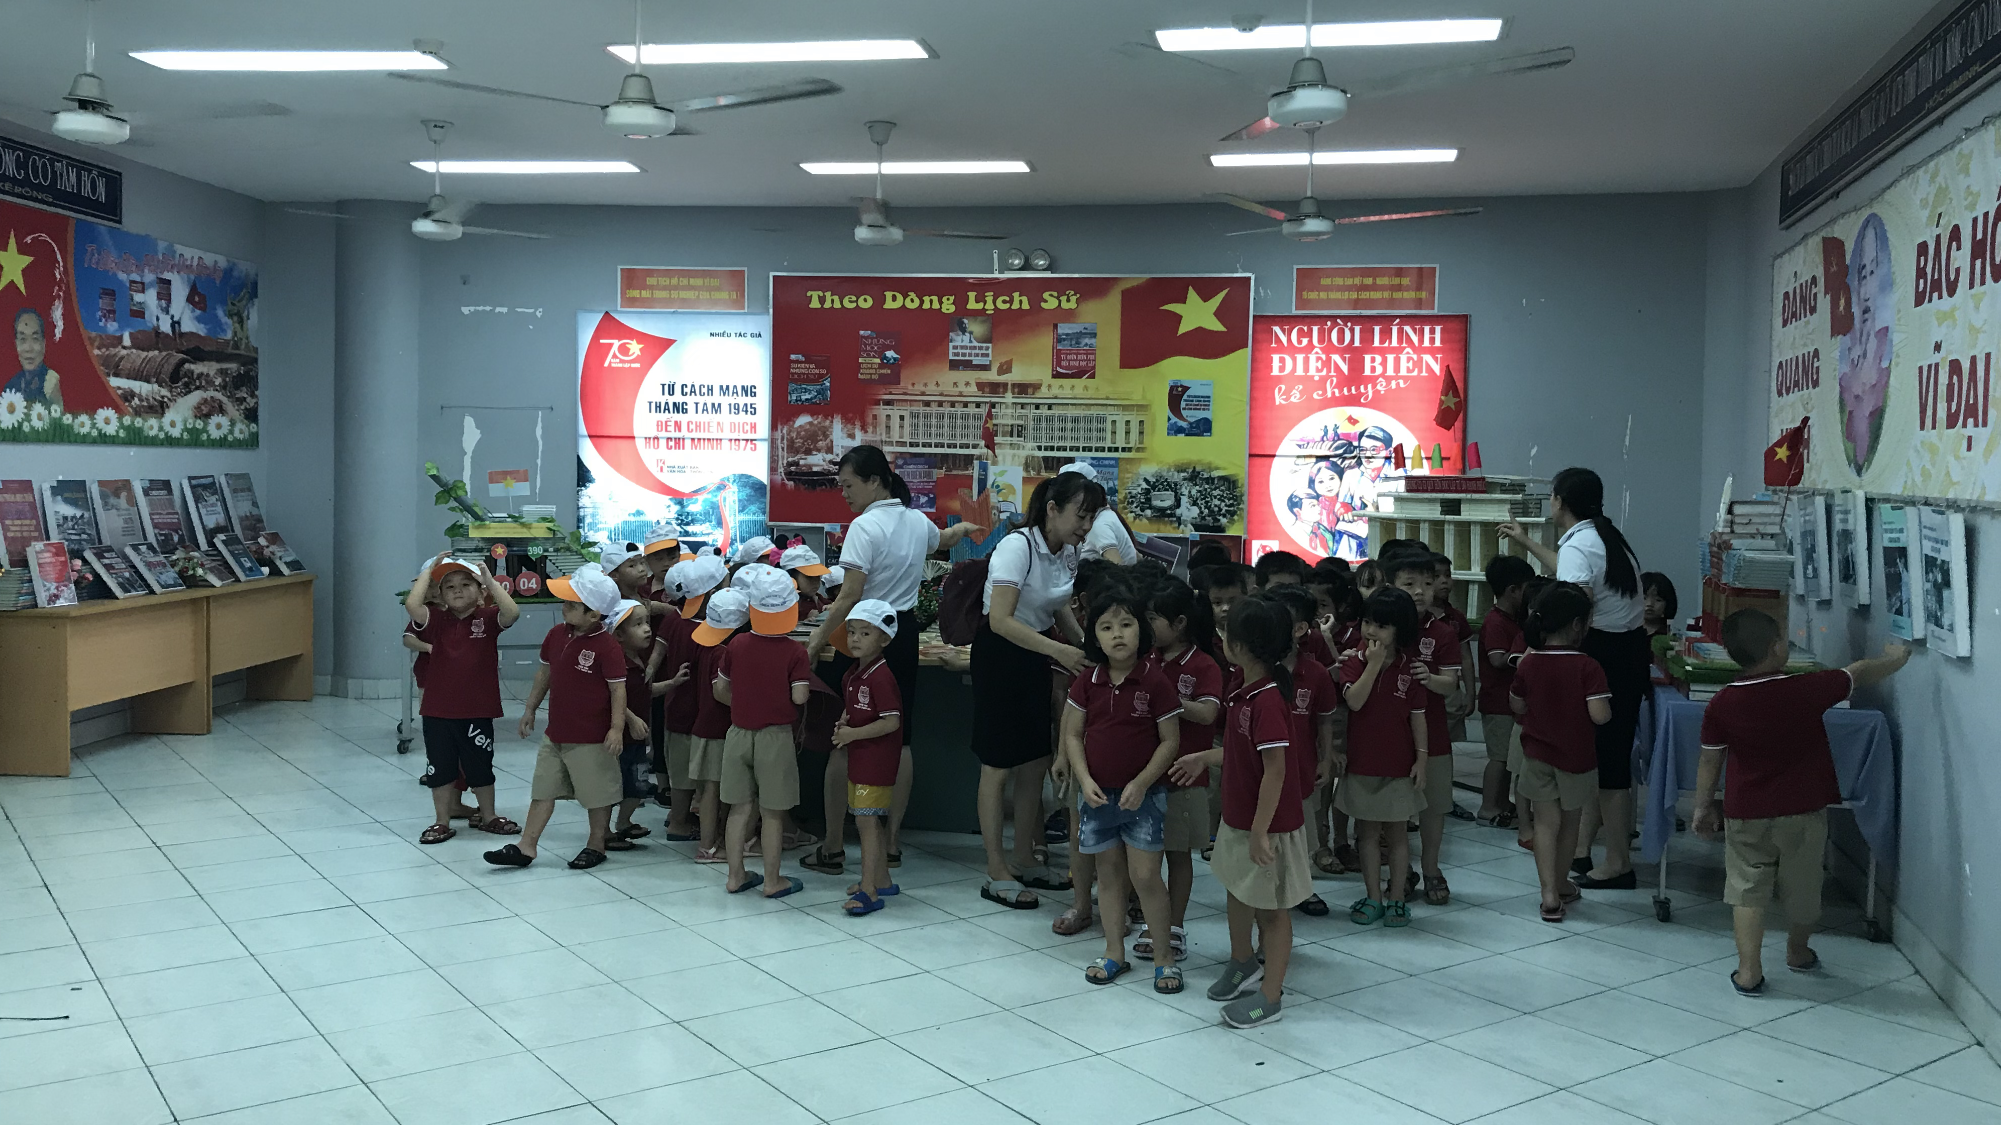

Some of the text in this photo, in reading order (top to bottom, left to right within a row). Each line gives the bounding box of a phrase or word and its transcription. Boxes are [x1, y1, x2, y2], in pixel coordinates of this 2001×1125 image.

[29, 156, 51, 186] CÓ
[54, 160, 77, 193] TÂM
[1913, 211, 1962, 308] BÁC
[806, 289, 1081, 315] Theo Dòng Lịch Sử
[1781, 270, 1818, 328] ĐẢNG
[1270, 317, 1443, 347] NGƯỜI LÍNH
[599, 339, 640, 367] 70
[1270, 347, 1443, 381] ĐIỆN BIÊN
[1775, 347, 1820, 398] QUANG
[660, 380, 757, 400] TỪ CÁCH MẠNG
[1274, 376, 1411, 405] kể chuyện
[1917, 340, 1992, 452] VĨ ĐẠI
[647, 399, 757, 416] THÁNG TÁM 1945
[656, 417, 682, 433] ĐẾN
[730, 421, 757, 437] DỊCH
[644, 435, 758, 452] HỒ CHÍ MINH 1975
[527, 545, 543, 555] 390
[519, 577, 538, 590] 04
